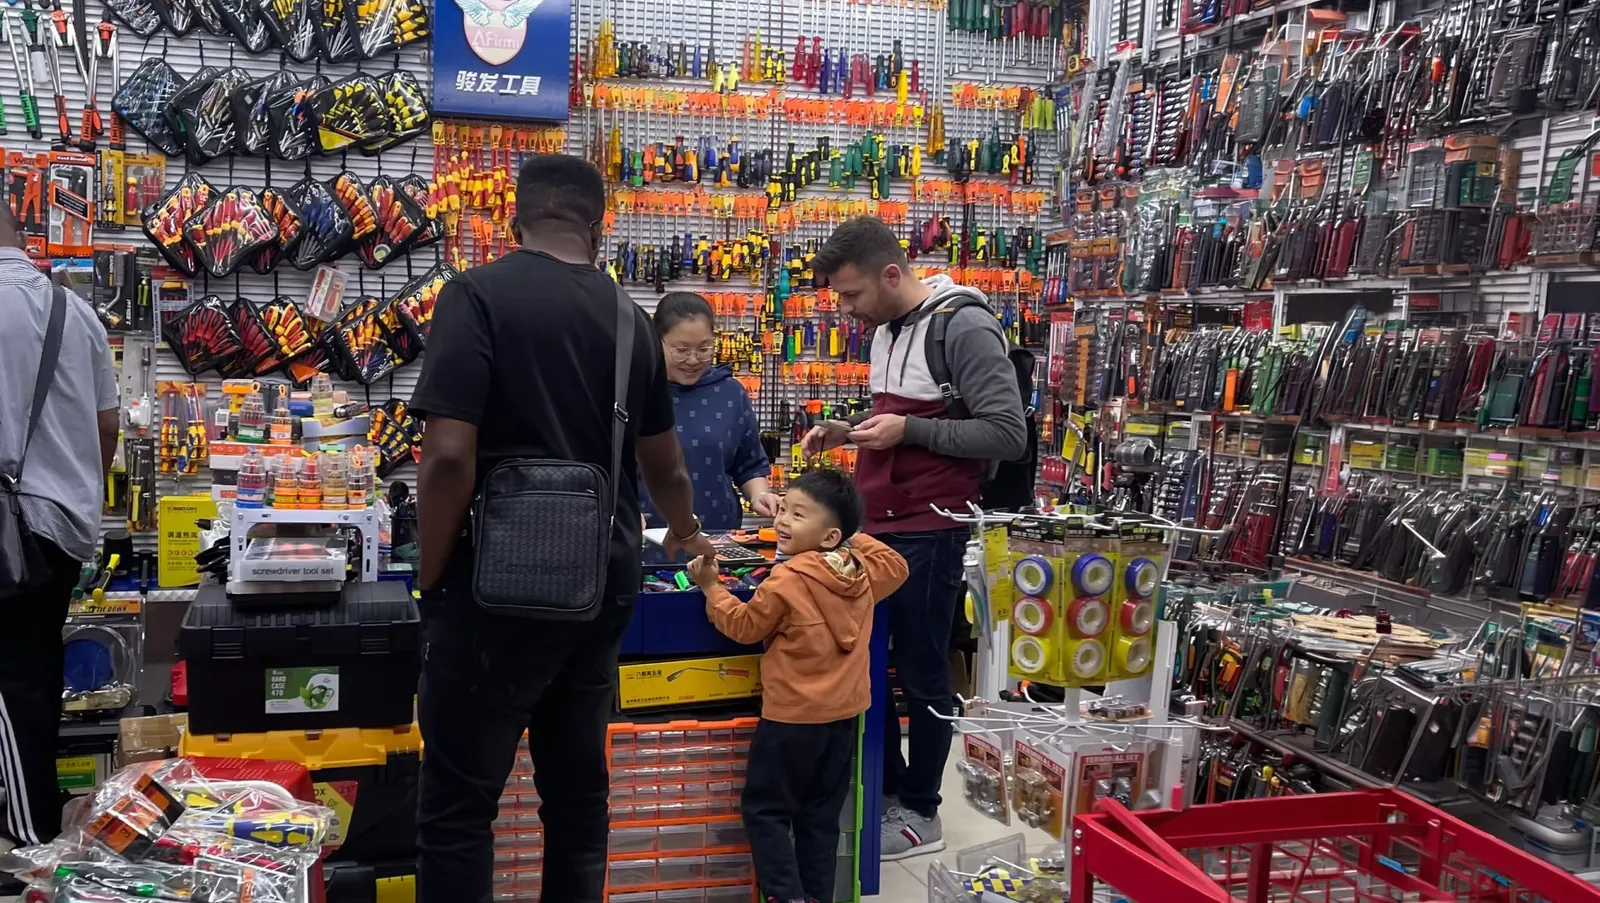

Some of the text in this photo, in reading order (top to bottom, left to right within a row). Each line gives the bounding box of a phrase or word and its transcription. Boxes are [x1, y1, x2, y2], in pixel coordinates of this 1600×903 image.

[455, 70, 541, 96] 骏发工具
[252, 567, 334, 575] screwdriver tool set
[271, 675, 287, 683] HARD
[1085, 753, 1140, 764] TERMINAL SET
